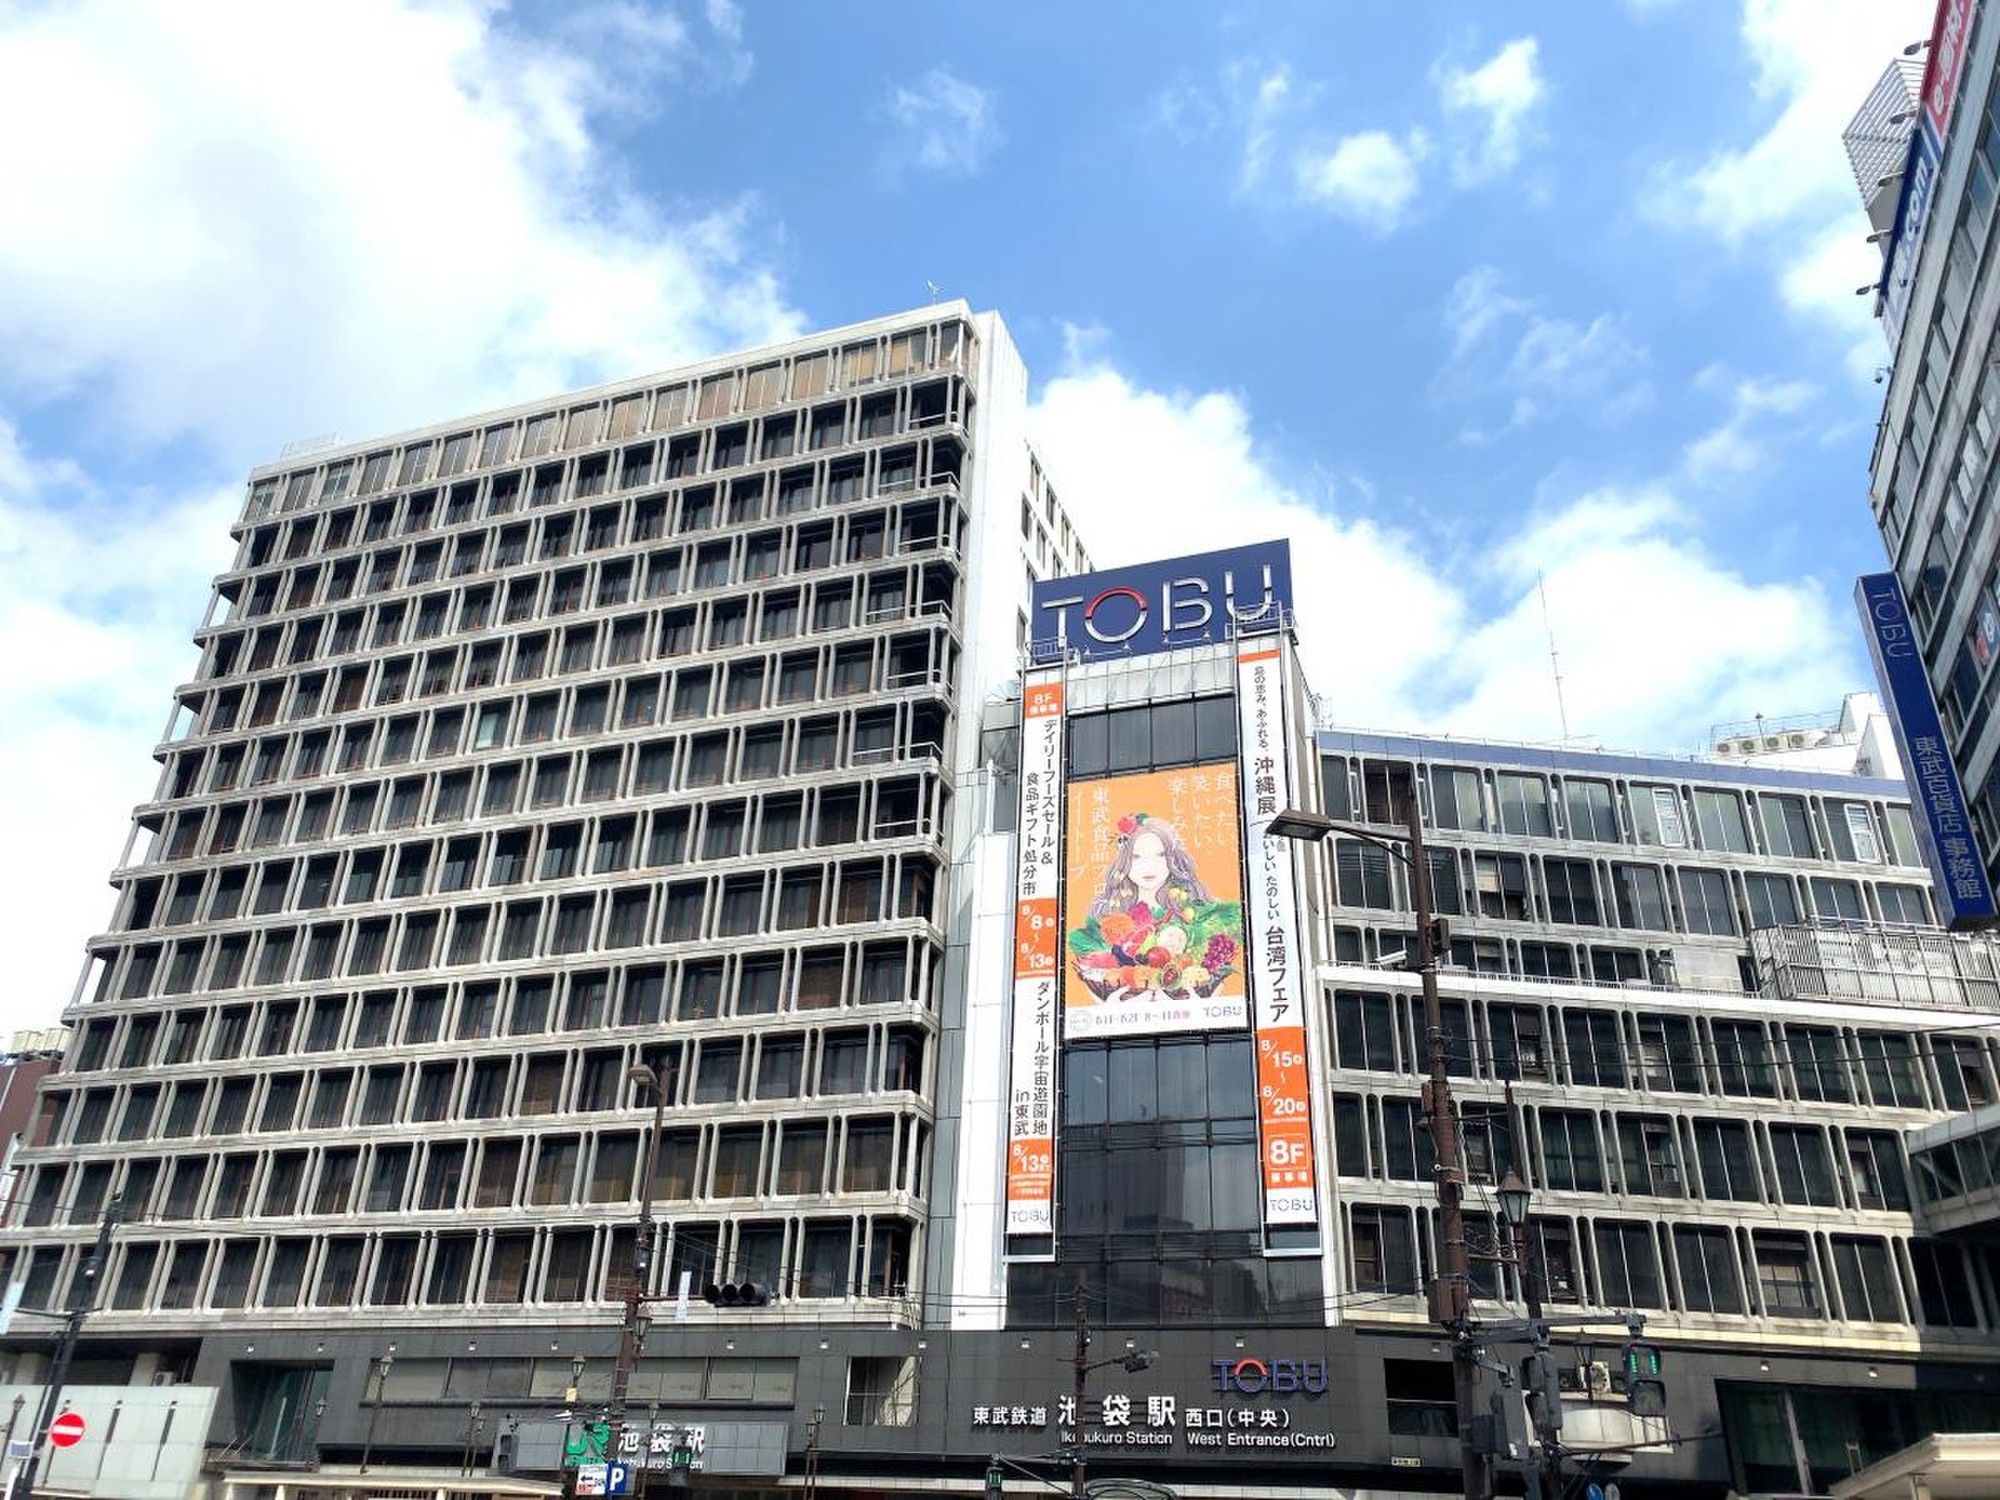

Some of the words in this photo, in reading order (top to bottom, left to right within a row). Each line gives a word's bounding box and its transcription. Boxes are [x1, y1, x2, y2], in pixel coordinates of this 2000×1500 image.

[1042, 564, 1272, 648] TOBU
[1872, 588, 1914, 657] TOBU
[1034, 693, 1053, 706] 8F
[1254, 756, 1277, 816] 沖縄展
[1023, 772, 1040, 896] 食品ギフト処分市
[1266, 875, 1280, 920] たのしい
[1266, 925, 1289, 1023] 台湾フェア
[1203, 1006, 1243, 1018] TOBU
[1032, 981, 1050, 1136] ダンボール宇宙遊園地
[1270, 1140, 1305, 1165] 8F
[1269, 1199, 1313, 1212] TOBU
[1213, 1358, 1328, 1393] TOBU
[973, 1406, 1047, 1427] 東武鉄道
[1127, 1431, 1173, 1445] Station
[1187, 1432, 1222, 1446] West
[1227, 1432, 1335, 1447] Entrance(Cntrl)
[609, 1467, 625, 1491] P
